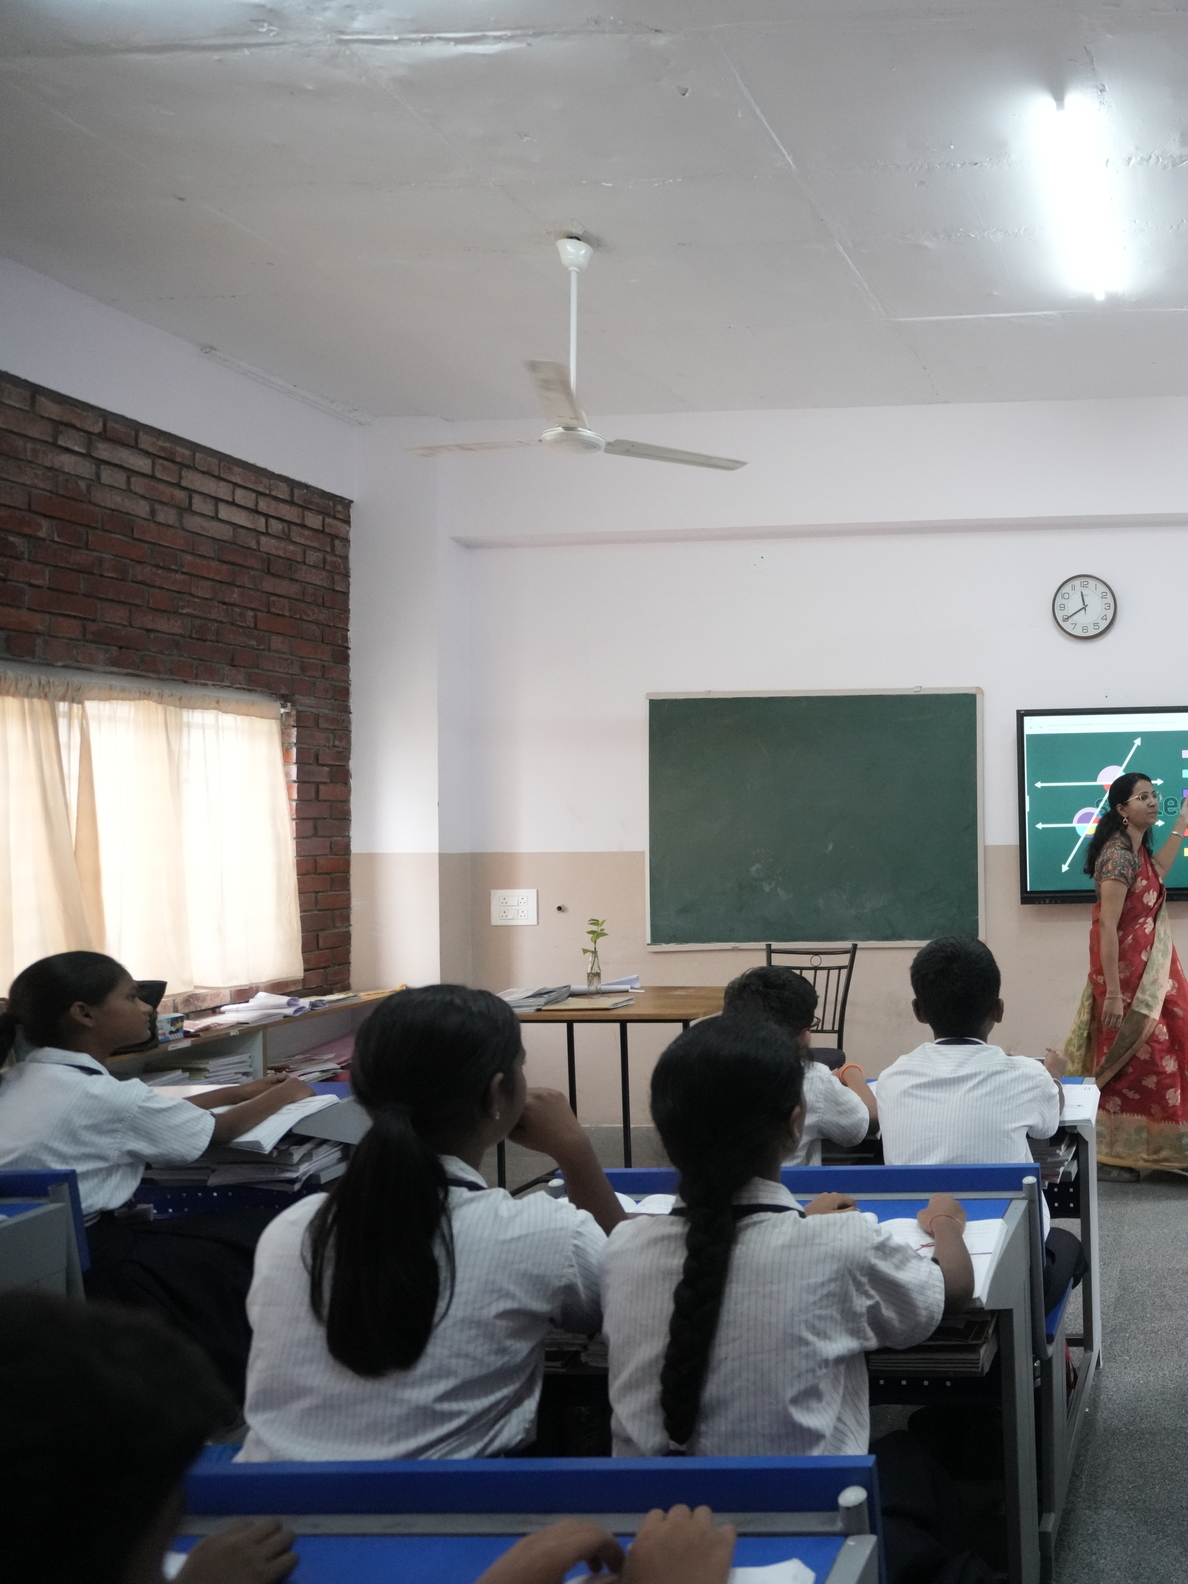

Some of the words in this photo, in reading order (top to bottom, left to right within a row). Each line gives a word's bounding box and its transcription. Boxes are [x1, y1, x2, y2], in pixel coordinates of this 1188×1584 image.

[1080, 580, 1089, 588] 12
[1061, 592, 1070, 600] 10
[1100, 591, 1108, 599] 2
[1058, 603, 1066, 611] 9
[1104, 602, 1111, 611] 3
[1093, 622, 1100, 630] 5
